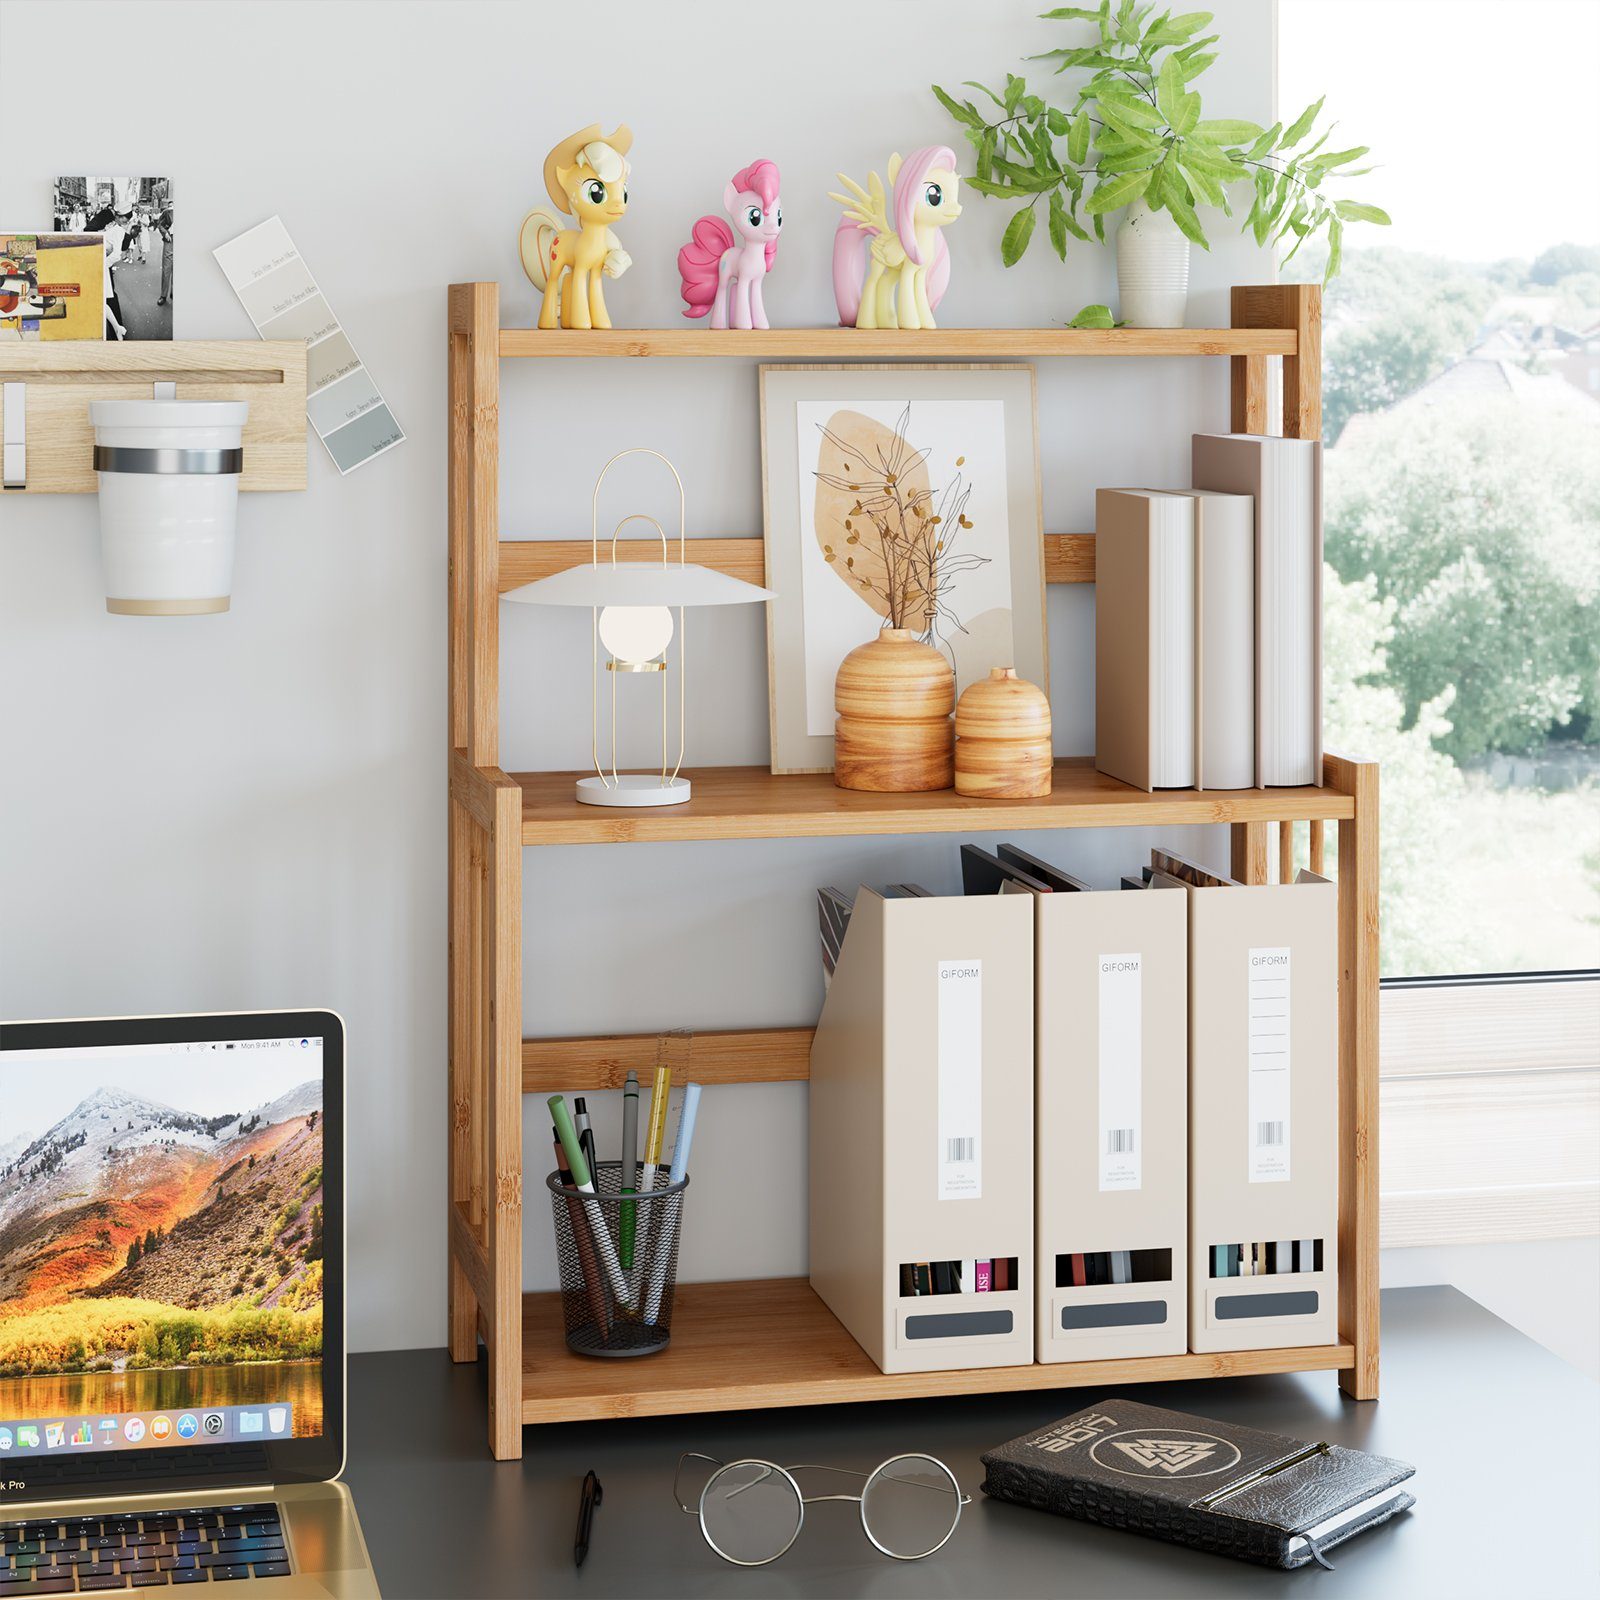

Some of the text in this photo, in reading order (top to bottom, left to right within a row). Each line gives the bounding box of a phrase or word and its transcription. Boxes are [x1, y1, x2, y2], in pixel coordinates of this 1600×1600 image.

[1252, 956, 1287, 966] GIFORM
[1102, 962, 1139, 972] GIFORM
[941, 969, 979, 979] GIFORM
[1025, 1413, 1101, 1447] NOTEBOOK
[1037, 1416, 1118, 1453] 2017
[9, 1480, 25, 1489] Pro
